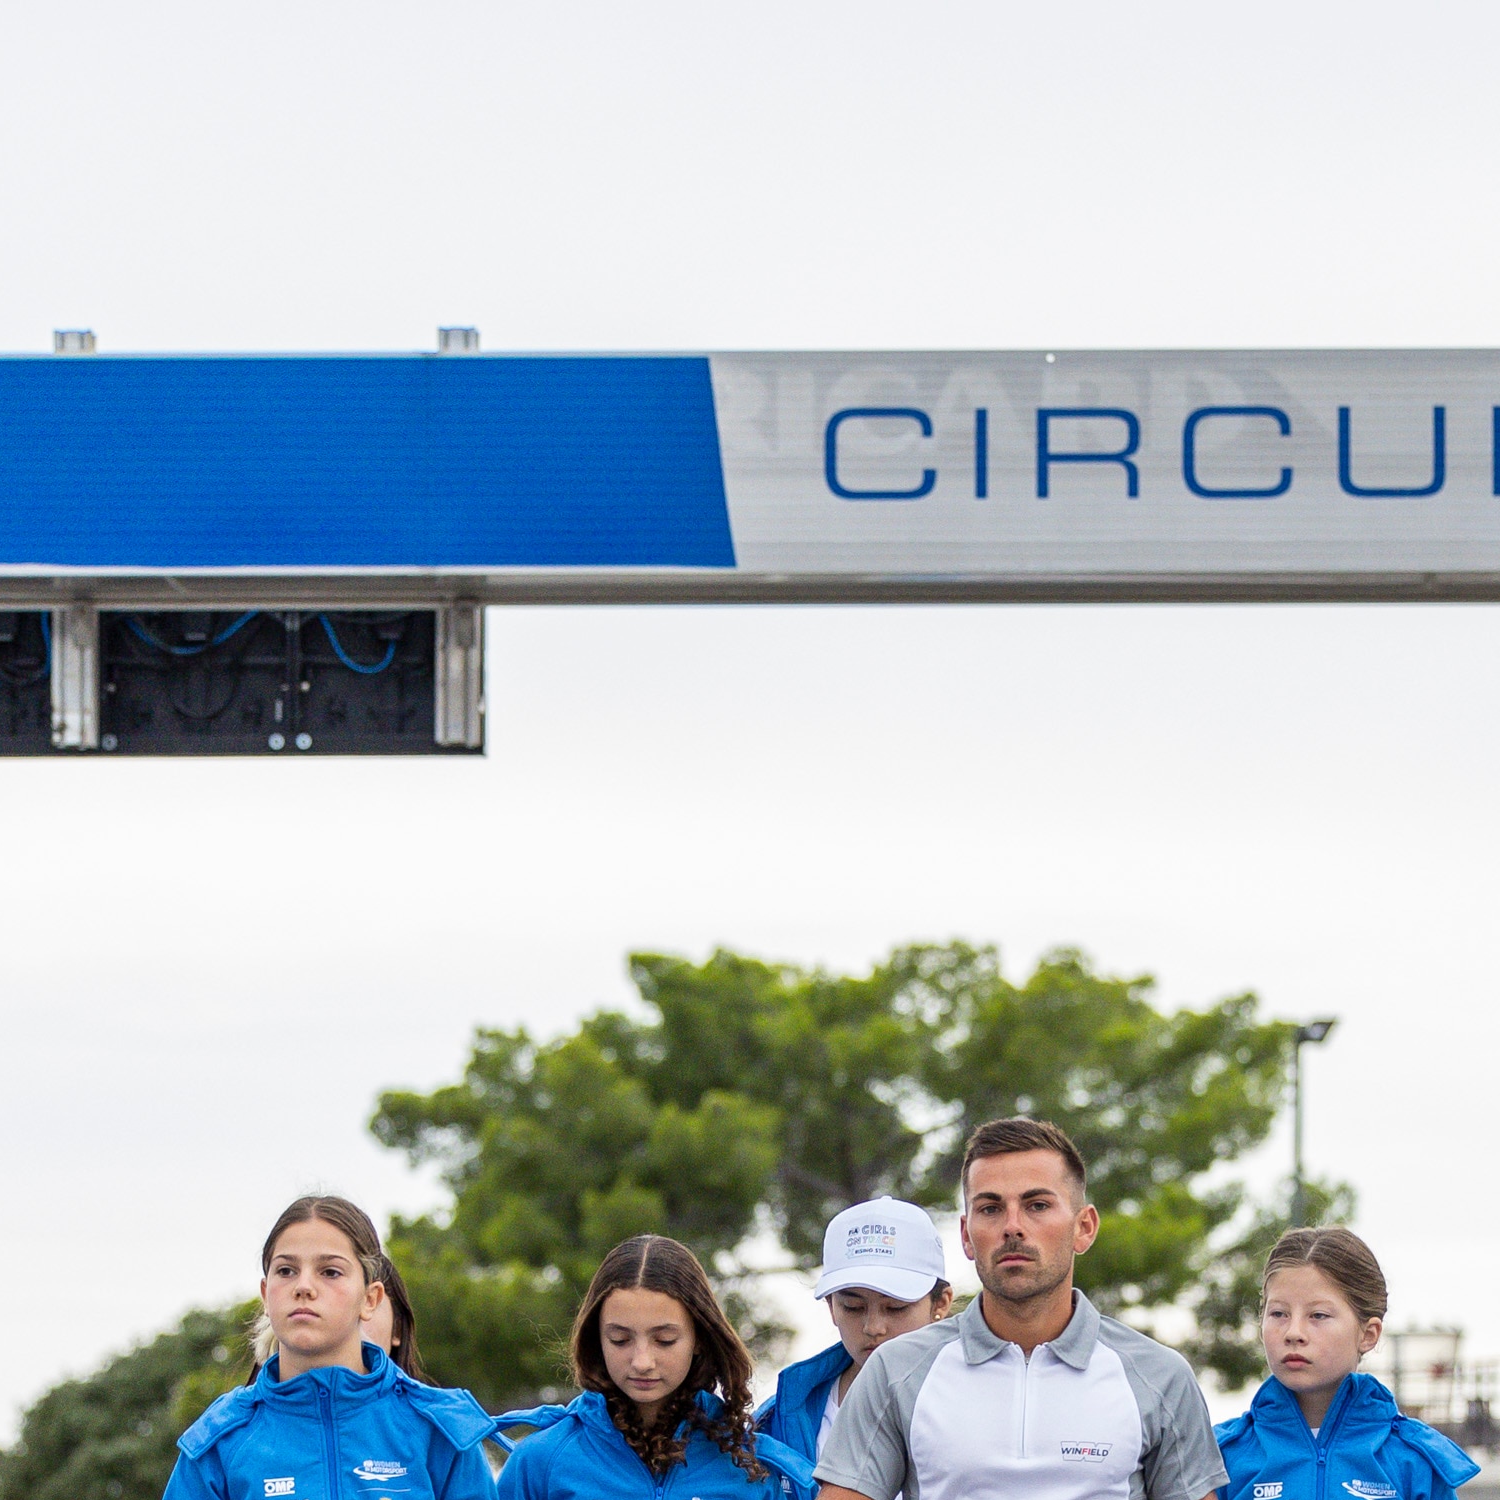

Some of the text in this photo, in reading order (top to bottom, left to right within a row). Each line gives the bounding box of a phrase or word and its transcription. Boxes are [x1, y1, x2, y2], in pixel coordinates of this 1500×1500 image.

[861, 1225, 896, 1235] GIRLS
[1061, 1447, 1109, 1457] WINFIELD
[264, 1480, 295, 1493] OMP
[1254, 1486, 1283, 1497] OMP
